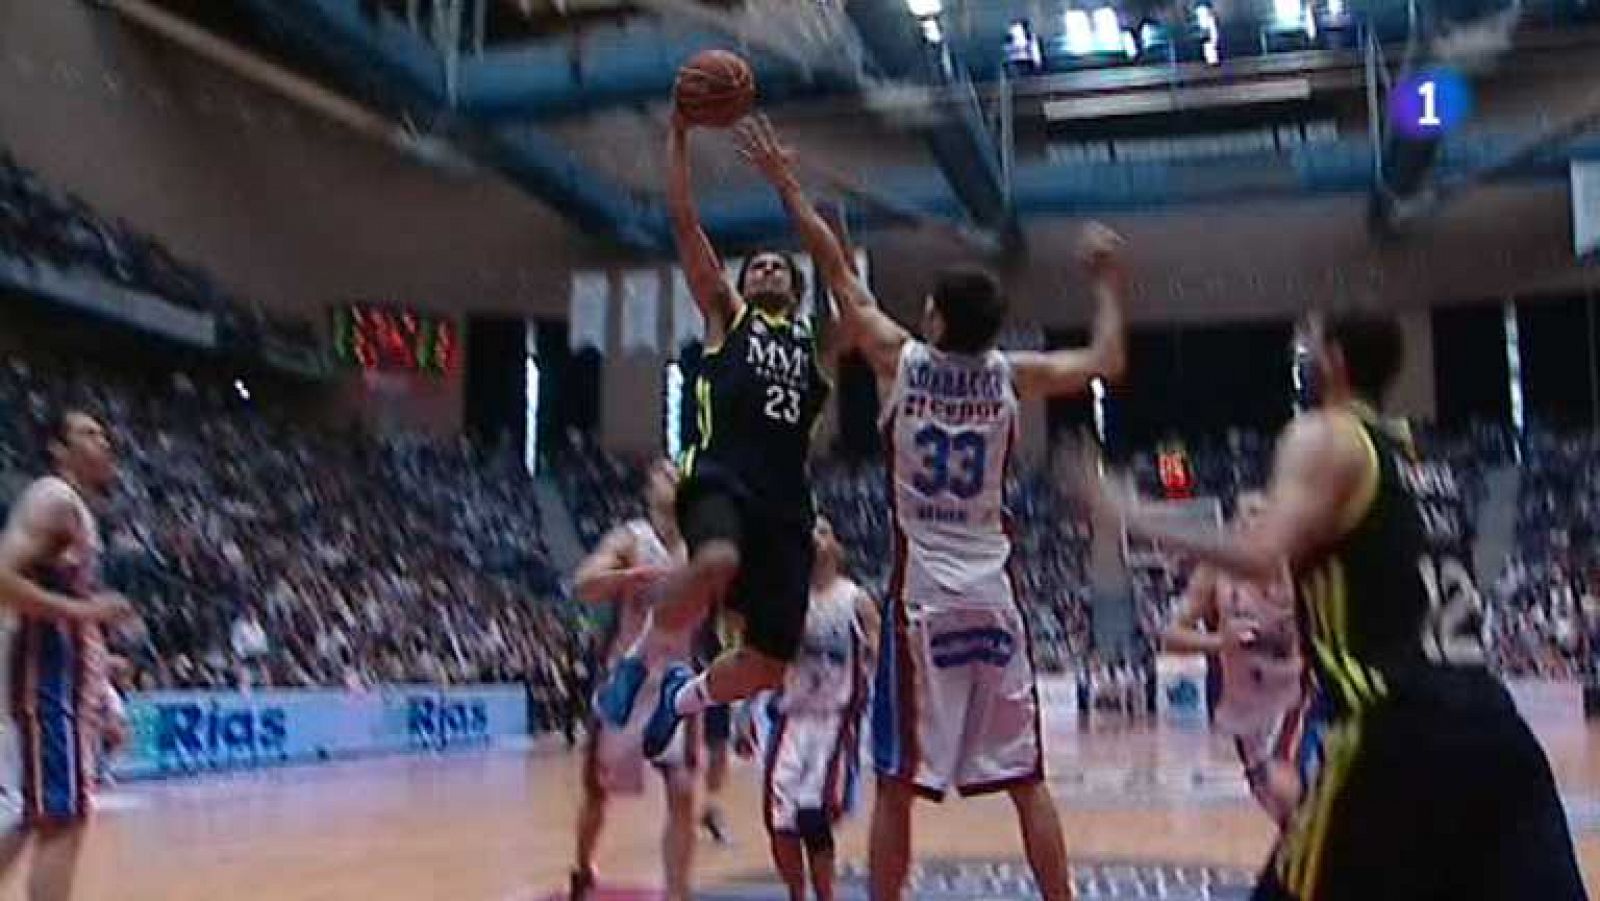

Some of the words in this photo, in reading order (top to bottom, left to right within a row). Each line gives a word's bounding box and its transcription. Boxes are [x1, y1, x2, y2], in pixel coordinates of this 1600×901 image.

[764, 385, 801, 425] 23
[913, 421, 985, 499] 33
[1417, 550, 1484, 663] 12
